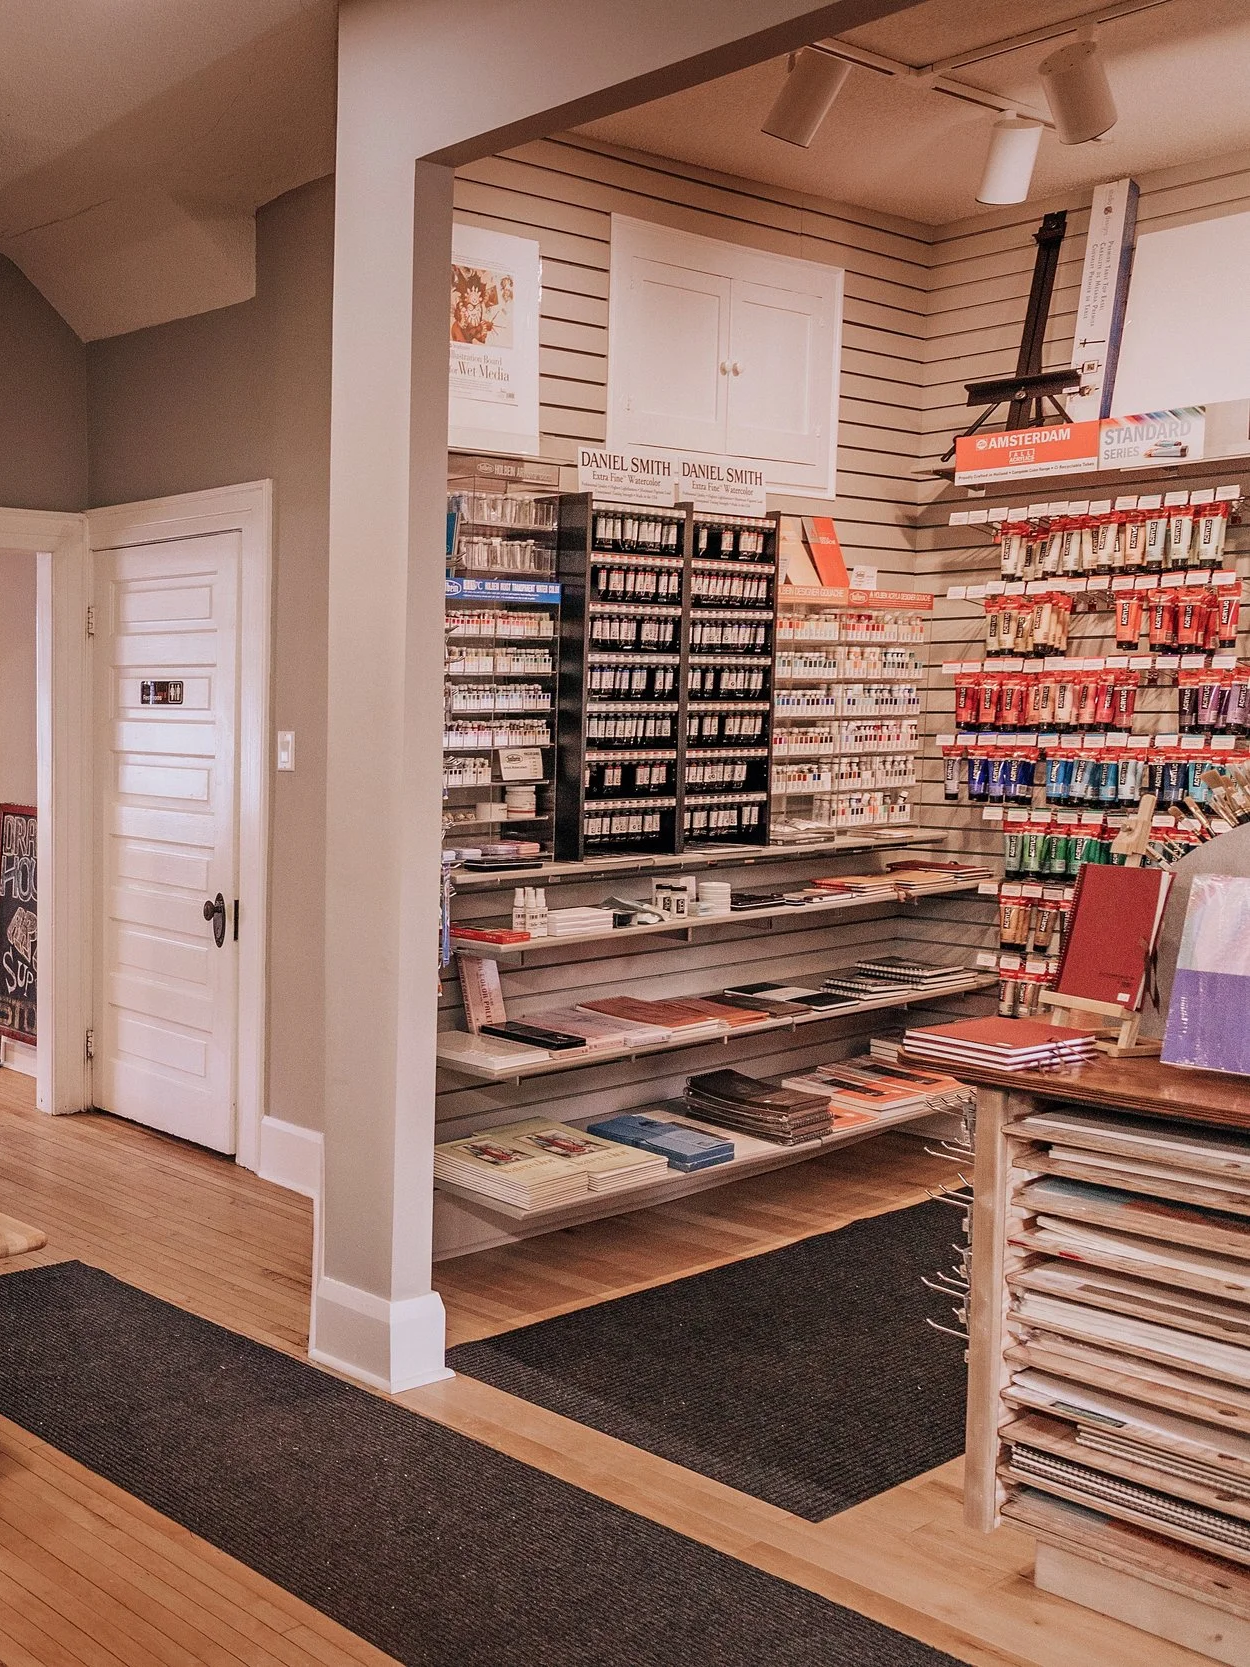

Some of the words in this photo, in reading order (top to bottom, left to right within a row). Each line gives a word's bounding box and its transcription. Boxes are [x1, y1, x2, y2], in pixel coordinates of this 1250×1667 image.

[484, 355, 502, 366] Board
[458, 361, 476, 376] Wet
[480, 364, 510, 381] Media
[988, 428, 1070, 450] AMSTERDAM
[1104, 421, 1191, 446] STANDARD
[1104, 446, 1140, 460] SERIES
[582, 452, 628, 472] DANIEL
[630, 457, 671, 476] SMITH
[682, 462, 724, 481] DANIEL
[726, 468, 763, 486] SMITH
[592, 471, 609, 482] Extra
[628, 474, 662, 486] Watercolor
[692, 481, 707, 490] Extra
[724, 484, 754, 496] Watercolor
